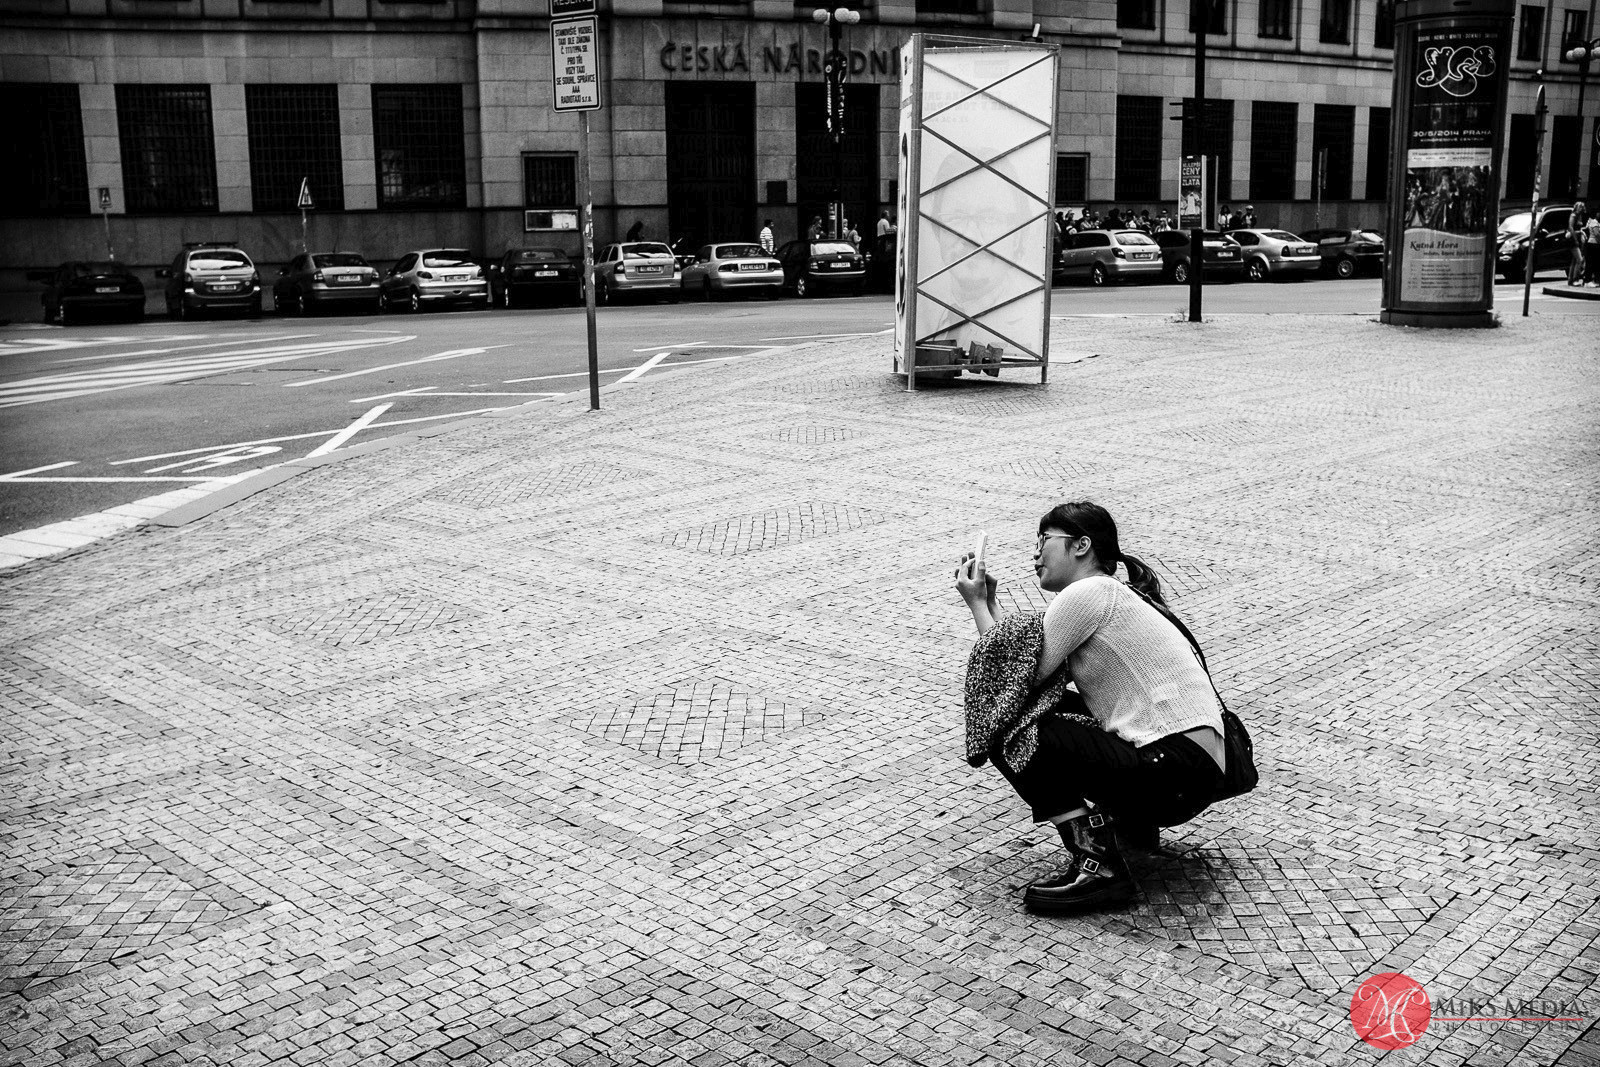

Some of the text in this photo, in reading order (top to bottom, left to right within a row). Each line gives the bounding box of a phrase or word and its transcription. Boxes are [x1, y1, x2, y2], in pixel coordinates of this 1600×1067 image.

[660, 41, 750, 72] ČESKÁ
[572, 85, 580, 94] AAA
[1182, 167, 1201, 175] CENY
[1182, 178, 1201, 186] ZLATA
[1410, 239, 1459, 251] Kutná Hora
